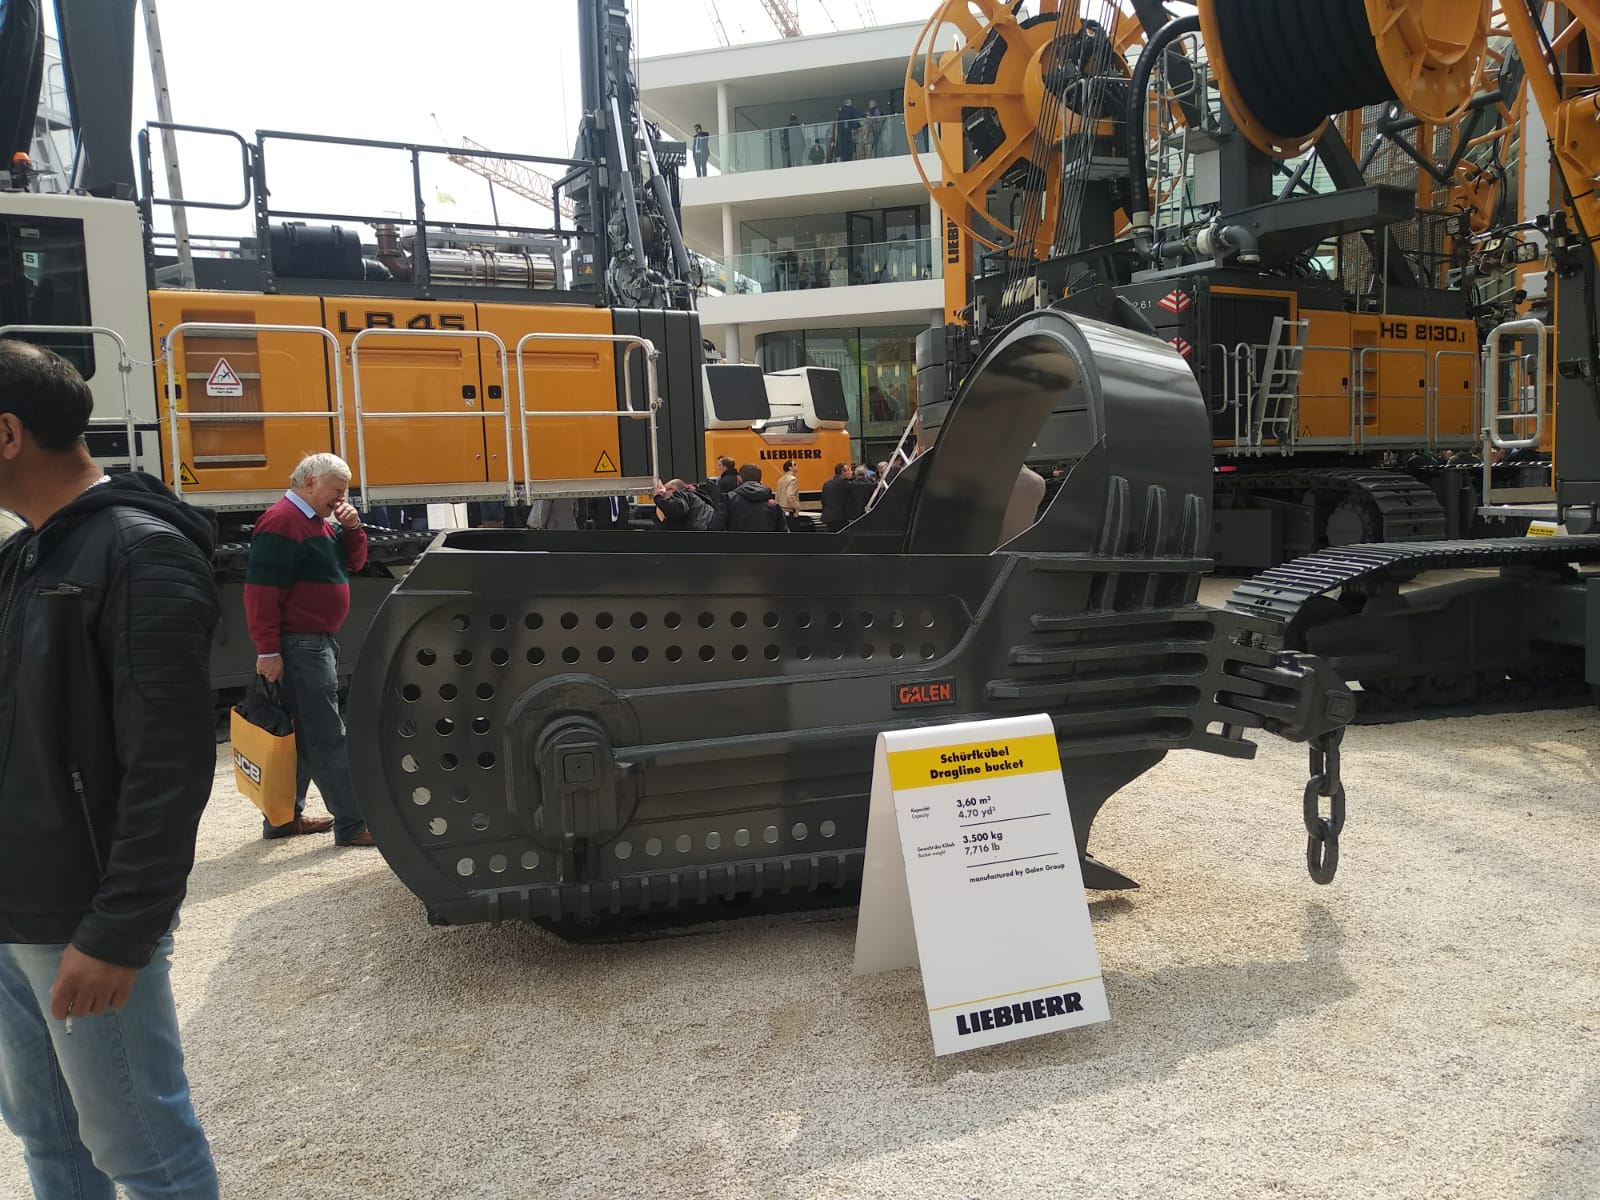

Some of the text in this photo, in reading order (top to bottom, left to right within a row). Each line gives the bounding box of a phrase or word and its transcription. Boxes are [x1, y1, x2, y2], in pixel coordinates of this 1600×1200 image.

[406, 313, 466, 331] 45
[1381, 322, 1407, 339] HS
[760, 449, 822, 460] LIEBHERR
[899, 683, 951, 704] GALEN
[940, 746, 1010, 764] Schürfkübel
[234, 750, 260, 784] JCB
[930, 759, 1024, 779] Dragline bucket
[956, 797, 977, 808] 3,60
[958, 808, 979, 819] 4.70
[962, 831, 1003, 844] 3.500 kg
[964, 842, 1000, 856] 7,716 lb
[969, 863, 1065, 883] manufactured by Galen Group
[956, 992, 1084, 1036] LIEBHERR
